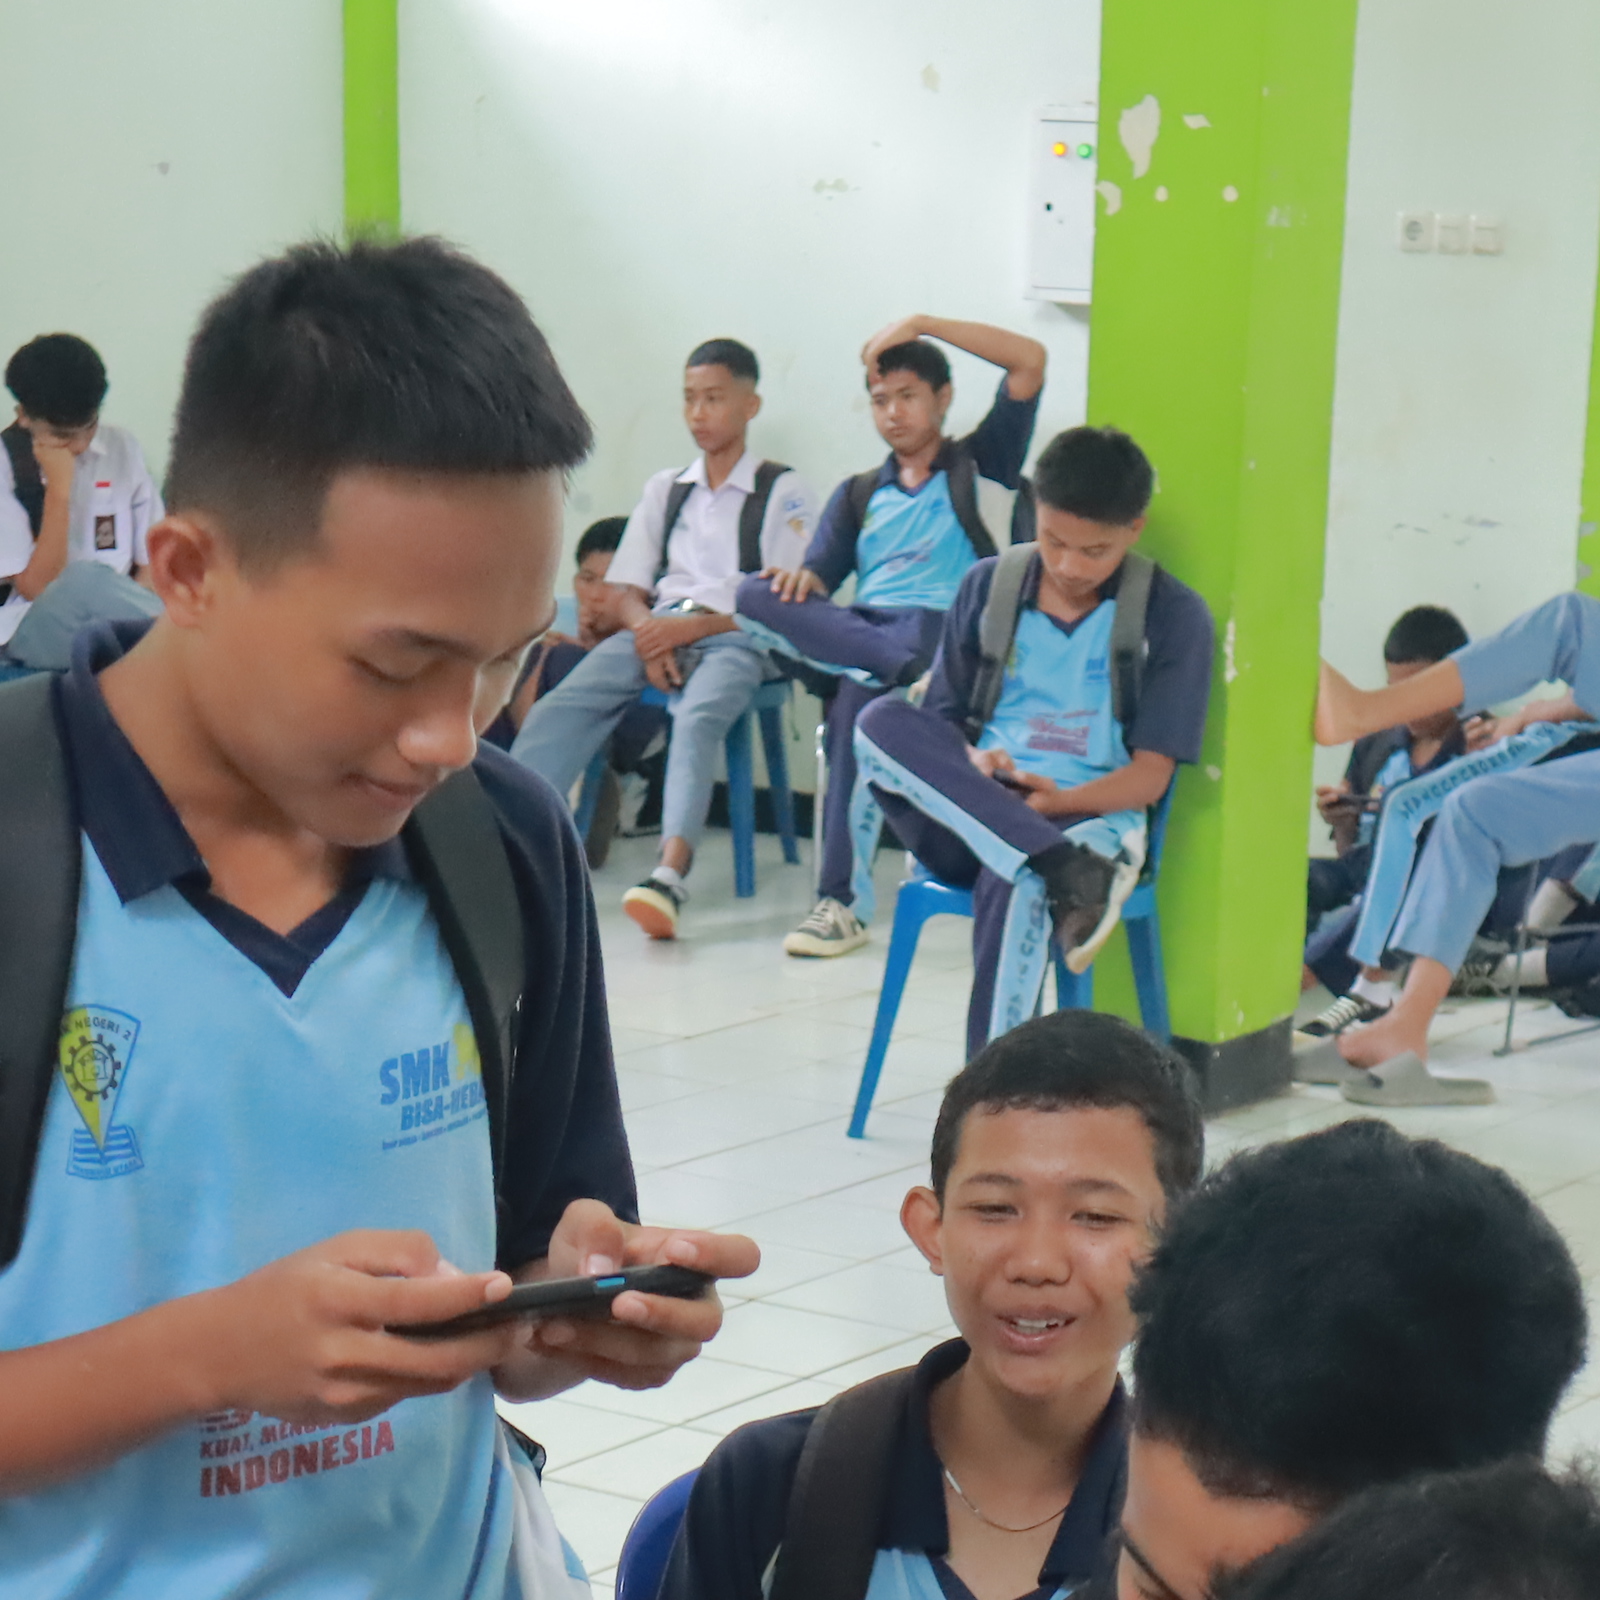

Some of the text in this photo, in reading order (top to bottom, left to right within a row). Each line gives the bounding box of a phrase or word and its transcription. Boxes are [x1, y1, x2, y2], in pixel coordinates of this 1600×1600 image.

[74, 1015, 120, 1035] NEGERI
[122, 1029, 132, 1041] 2
[379, 1040, 450, 1106] SMK
[201, 1421, 395, 1498] INDONESIA
